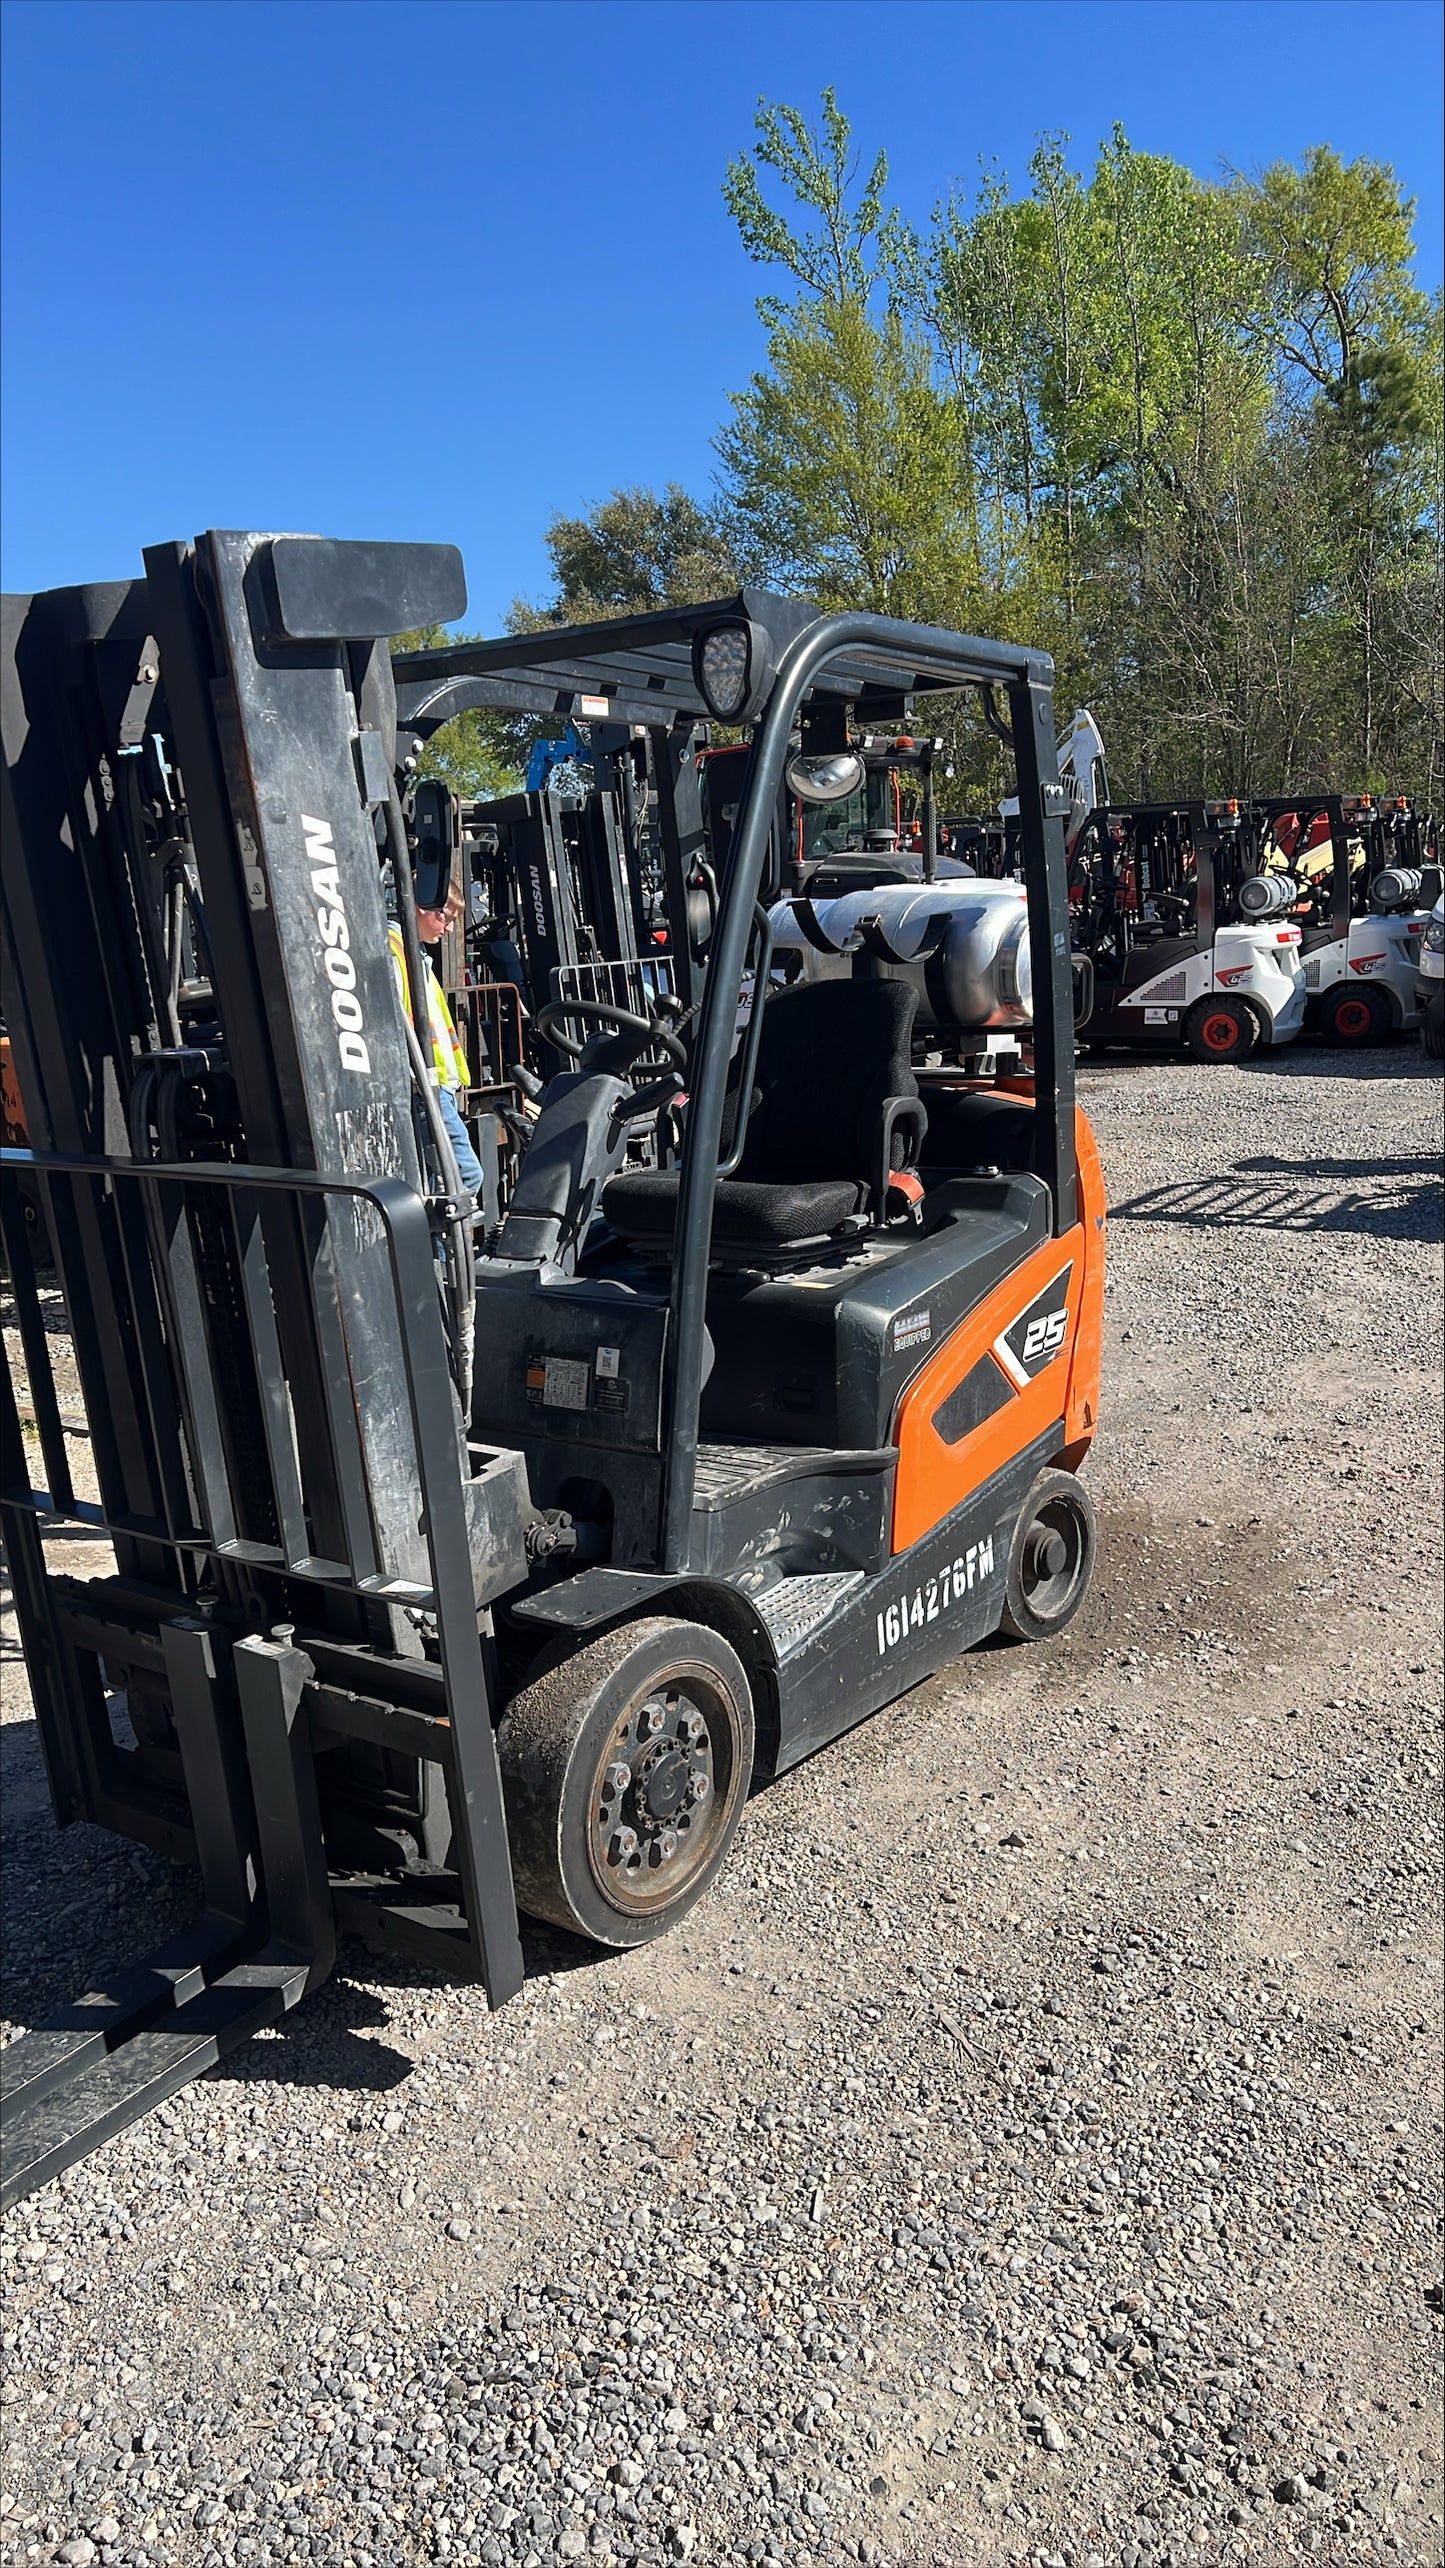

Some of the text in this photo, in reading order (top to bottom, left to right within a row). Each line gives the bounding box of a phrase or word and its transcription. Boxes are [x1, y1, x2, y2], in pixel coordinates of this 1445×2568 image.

[529, 864, 547, 937] DOOSAN
[1140, 861, 1151, 889] Bobcat
[301, 814, 371, 1074] DOOSAN
[893, 1327, 932, 1352] EQUIPPED
[1022, 1308, 1069, 1363] 25
[877, 1534, 995, 1656] 1614276FM
